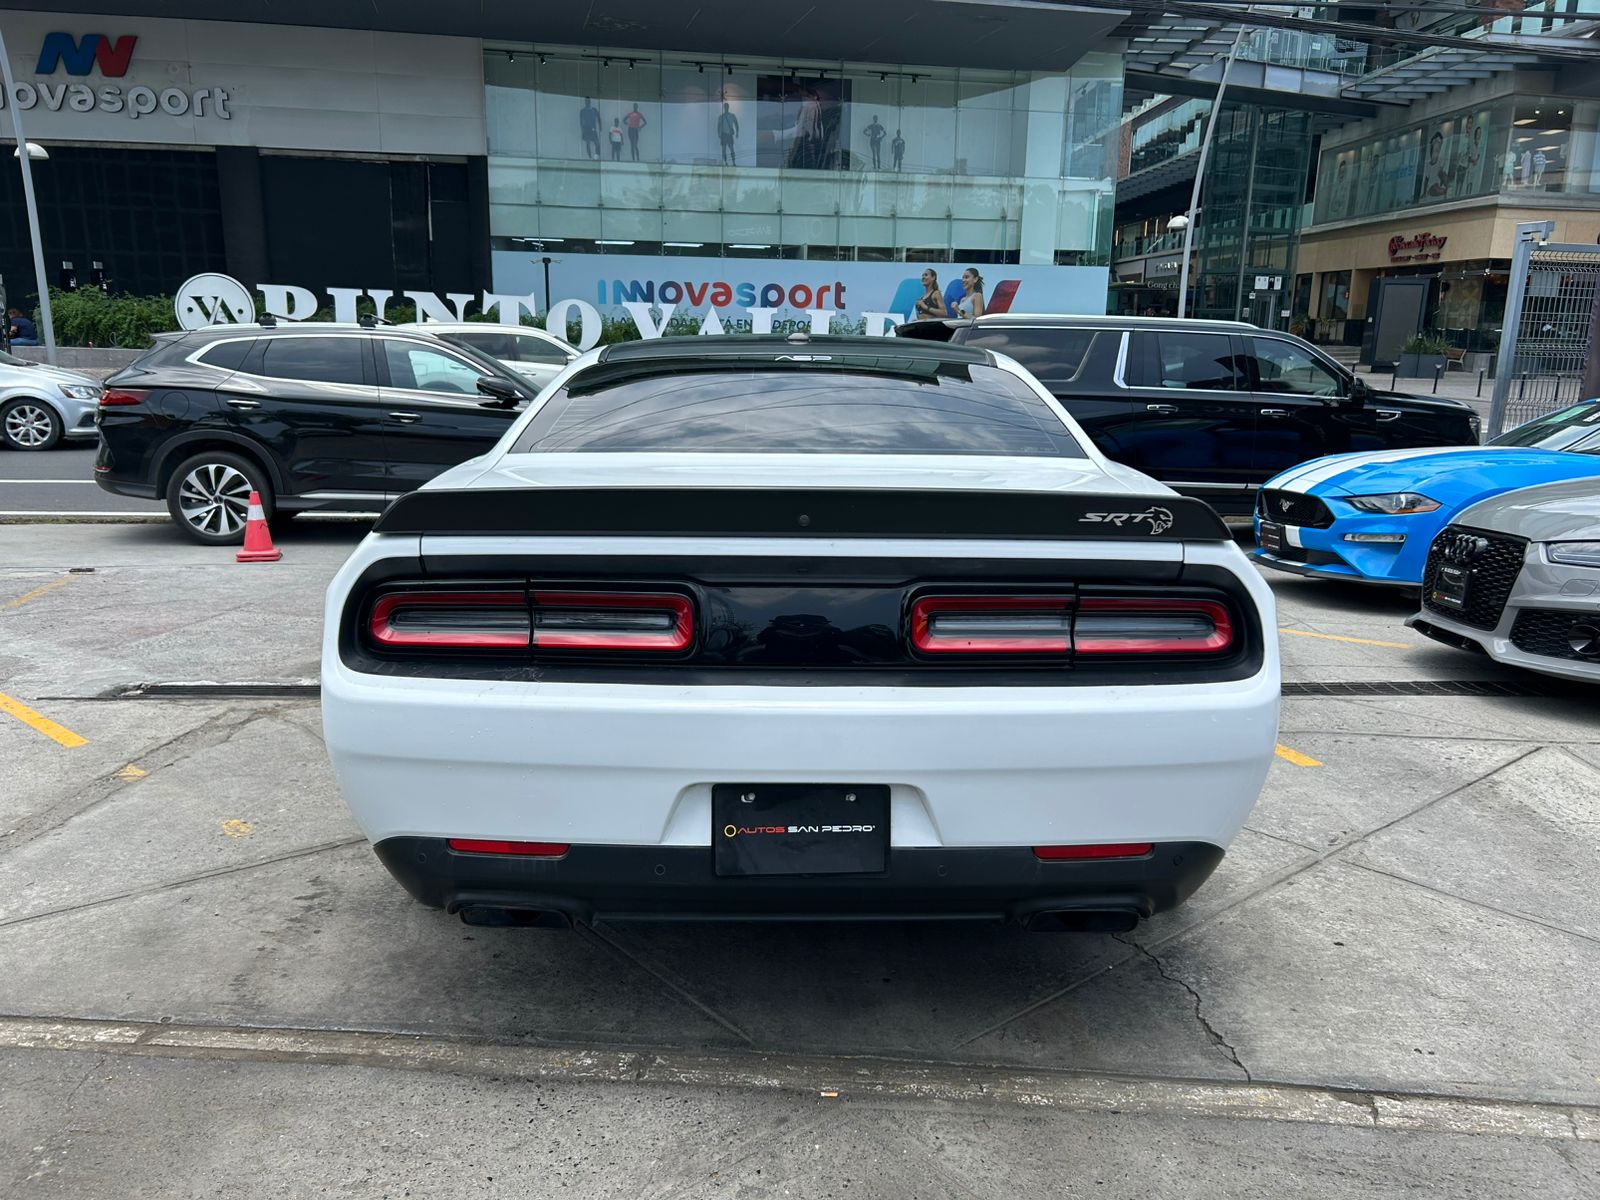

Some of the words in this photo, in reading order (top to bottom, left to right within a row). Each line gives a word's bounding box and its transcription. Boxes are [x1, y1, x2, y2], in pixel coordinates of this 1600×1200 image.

[0, 81, 232, 120] ovasport
[1169, 281, 1180, 289] ch
[1078, 512, 1154, 527] SRT
[737, 826, 785, 834] AUTOS
[787, 825, 819, 833] SAN
[821, 825, 873, 833] PEDRO
